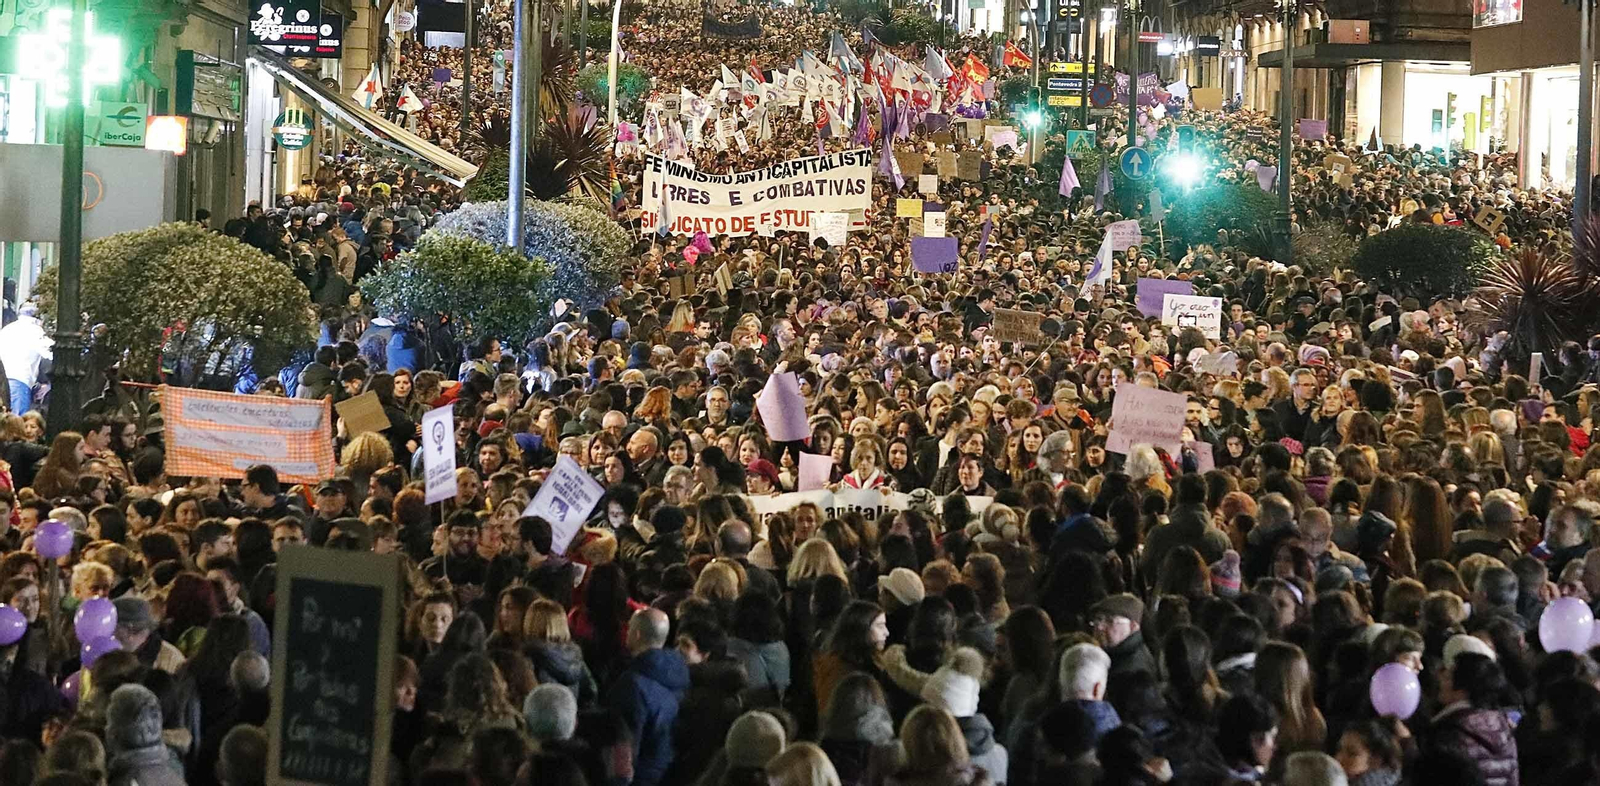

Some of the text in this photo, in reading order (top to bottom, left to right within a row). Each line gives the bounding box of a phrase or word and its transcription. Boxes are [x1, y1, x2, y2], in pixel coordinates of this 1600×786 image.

[1012, 57, 1032, 69] PCPE
[104, 132, 141, 142] iberCaja
[645, 150, 872, 185] FEMINISMO ANTICAPITALISTA
[651, 178, 866, 206] LBRES E COMBATIVAS
[731, 216, 756, 233] DE
[938, 261, 958, 273] VOZ
[1169, 298, 1186, 317] Yo
